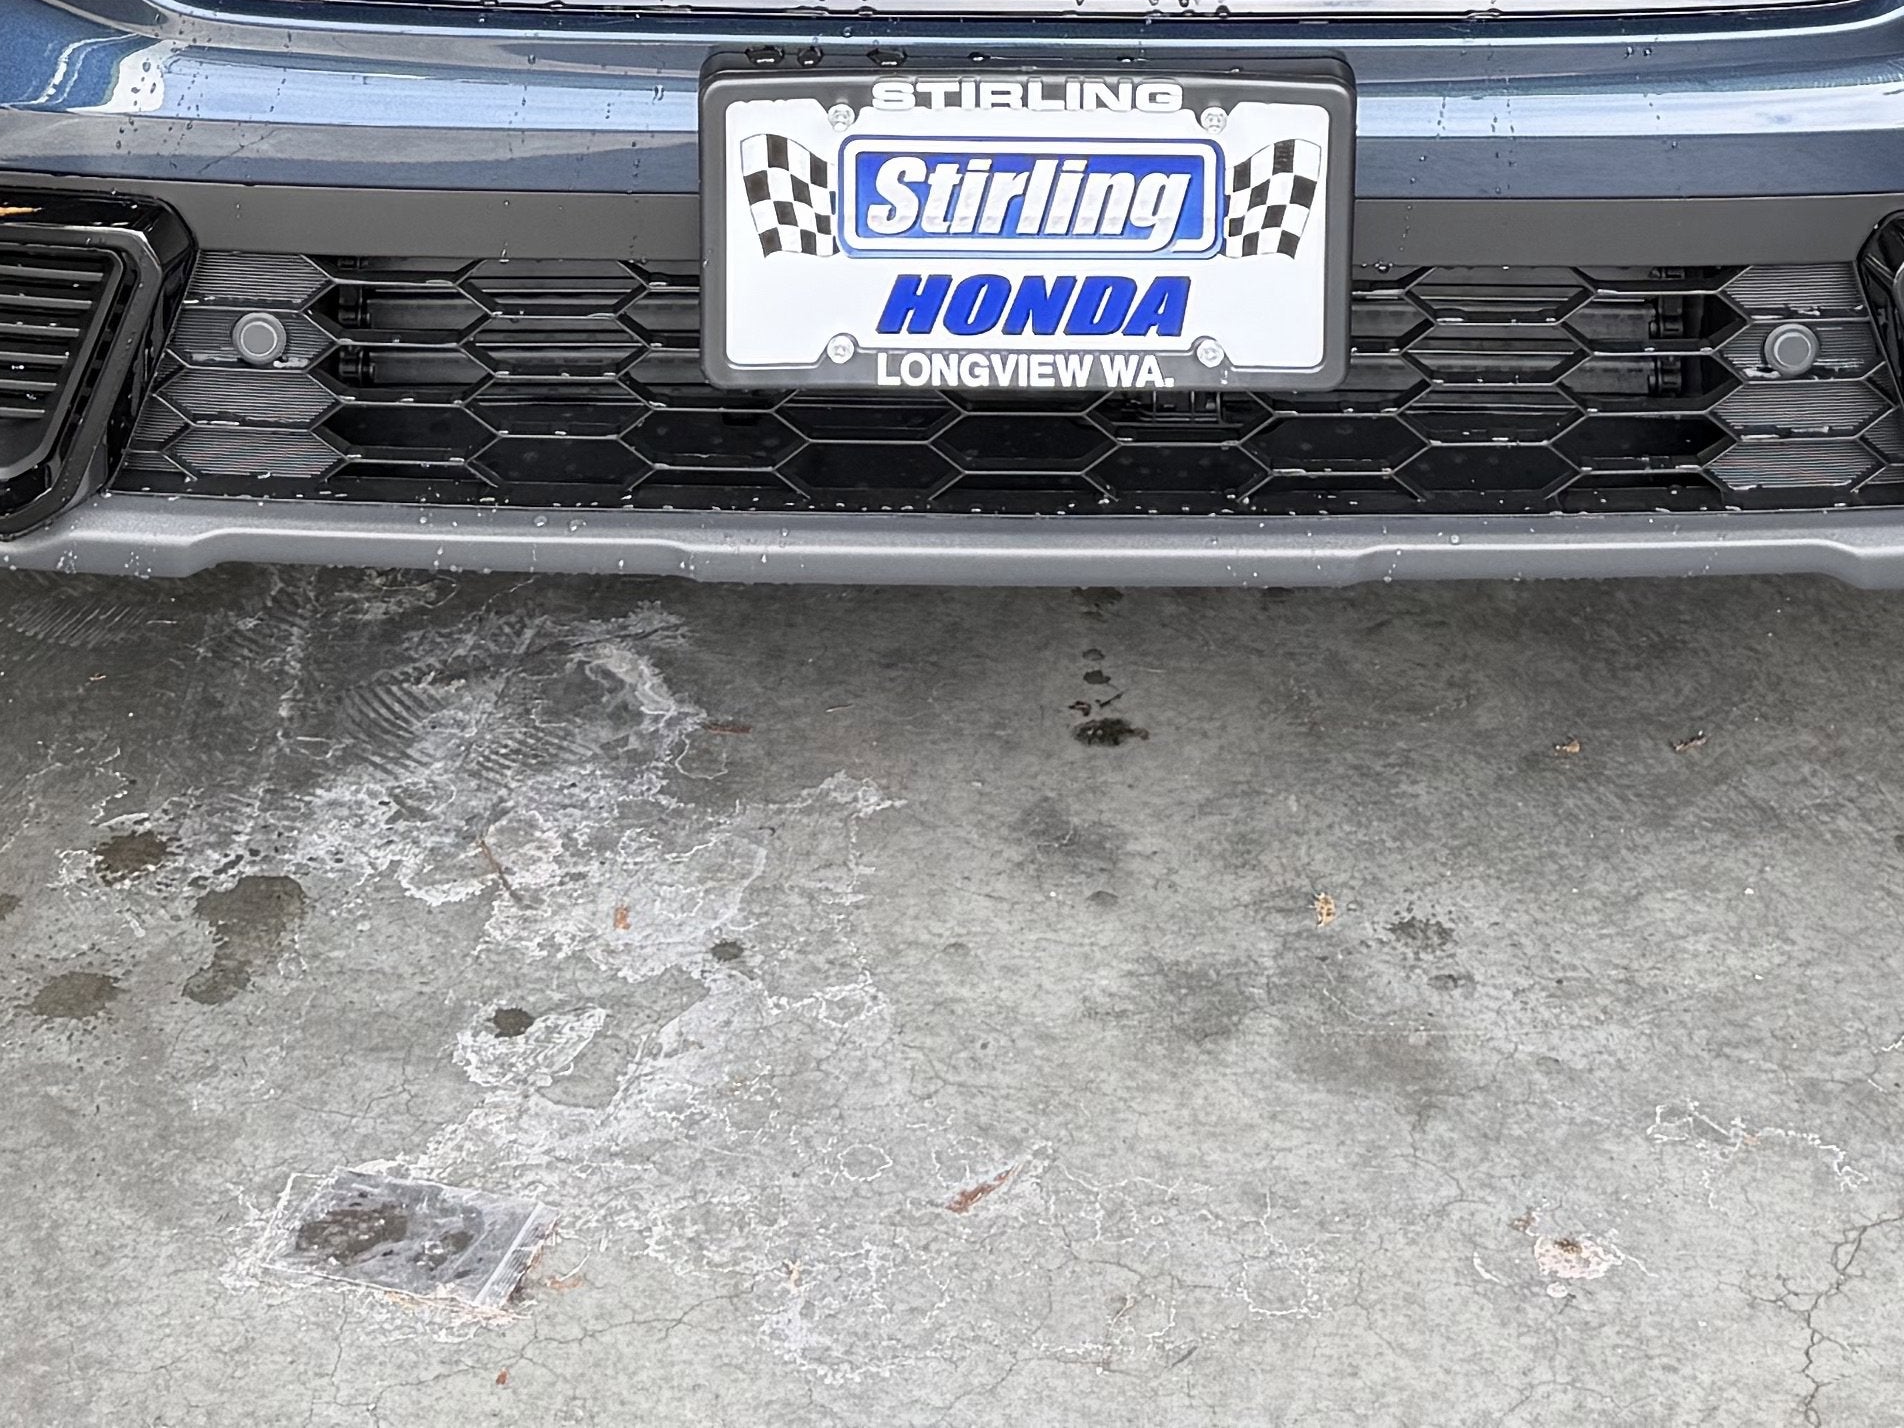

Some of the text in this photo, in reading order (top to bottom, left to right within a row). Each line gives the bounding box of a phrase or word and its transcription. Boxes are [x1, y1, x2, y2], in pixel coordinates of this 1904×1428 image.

[871, 82, 1184, 111] STIRLING
[866, 156, 1192, 252] Stirling
[875, 274, 1191, 336] HONDA
[877, 352, 1175, 387] LONGVIEW WA.
